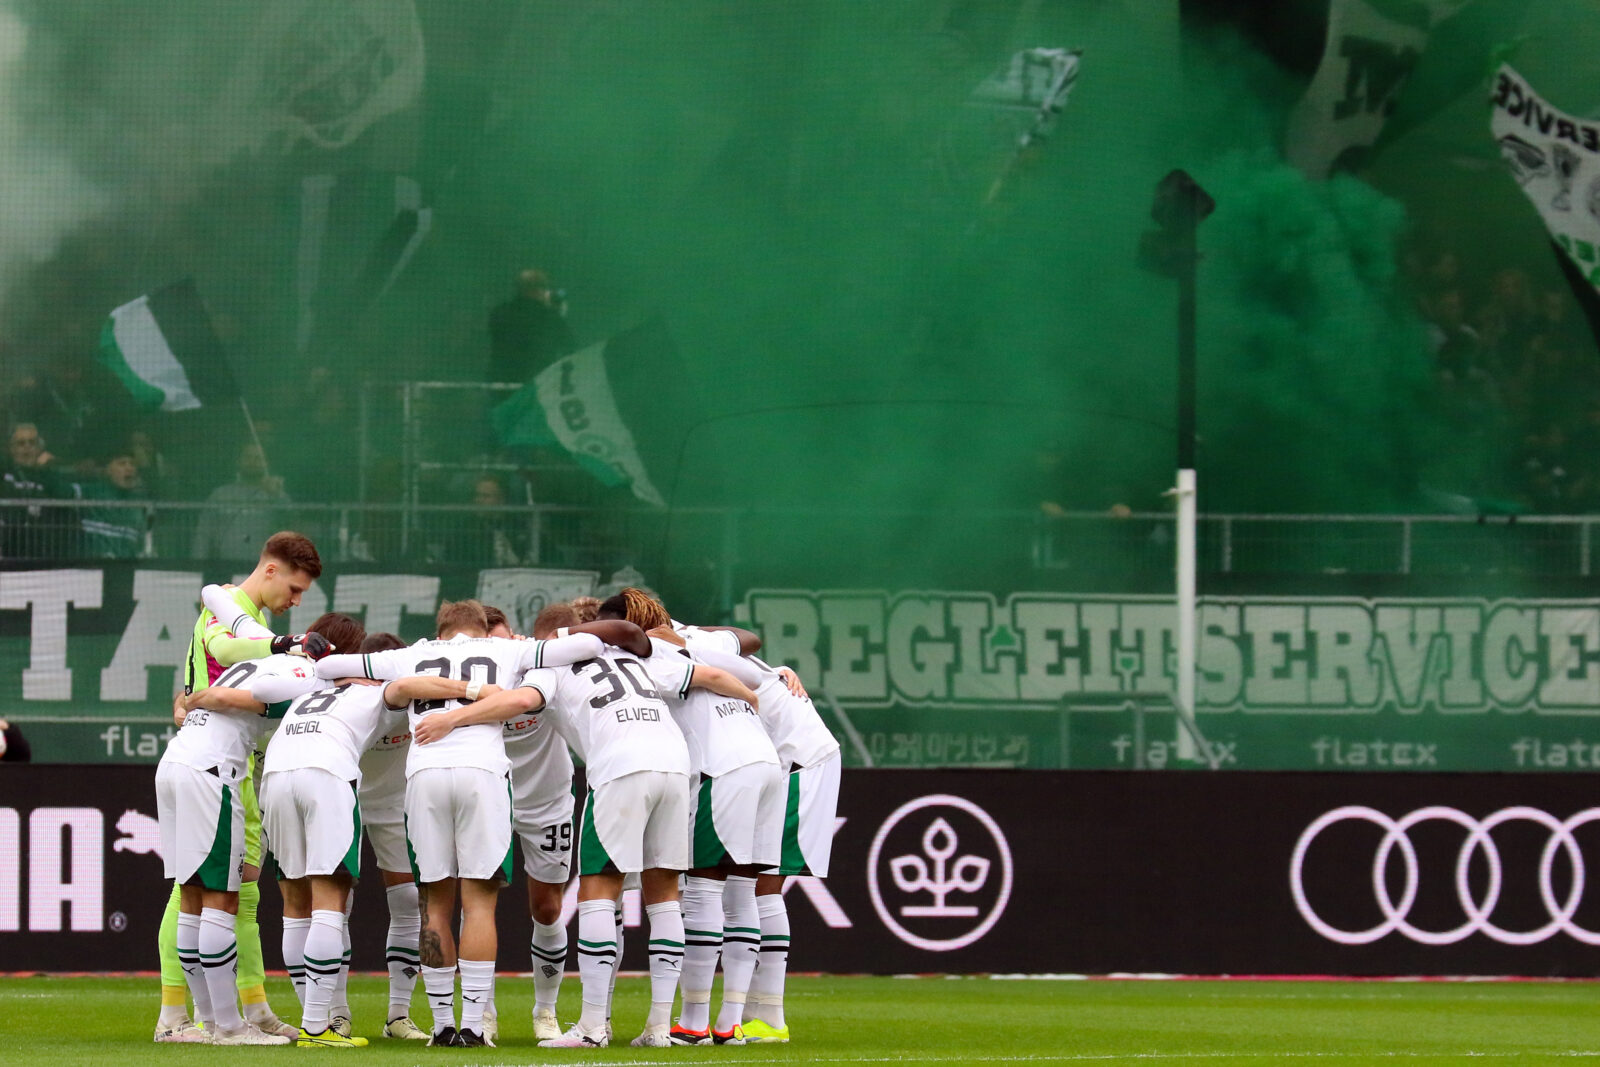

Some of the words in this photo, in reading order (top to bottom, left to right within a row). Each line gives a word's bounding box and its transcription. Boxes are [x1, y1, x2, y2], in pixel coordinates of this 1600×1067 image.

[571, 657, 660, 709] 30
[285, 721, 322, 736] WEIGL
[616, 707, 661, 723] ELVEDI
[1312, 738, 1438, 766] flatex
[540, 823, 572, 852] 39
